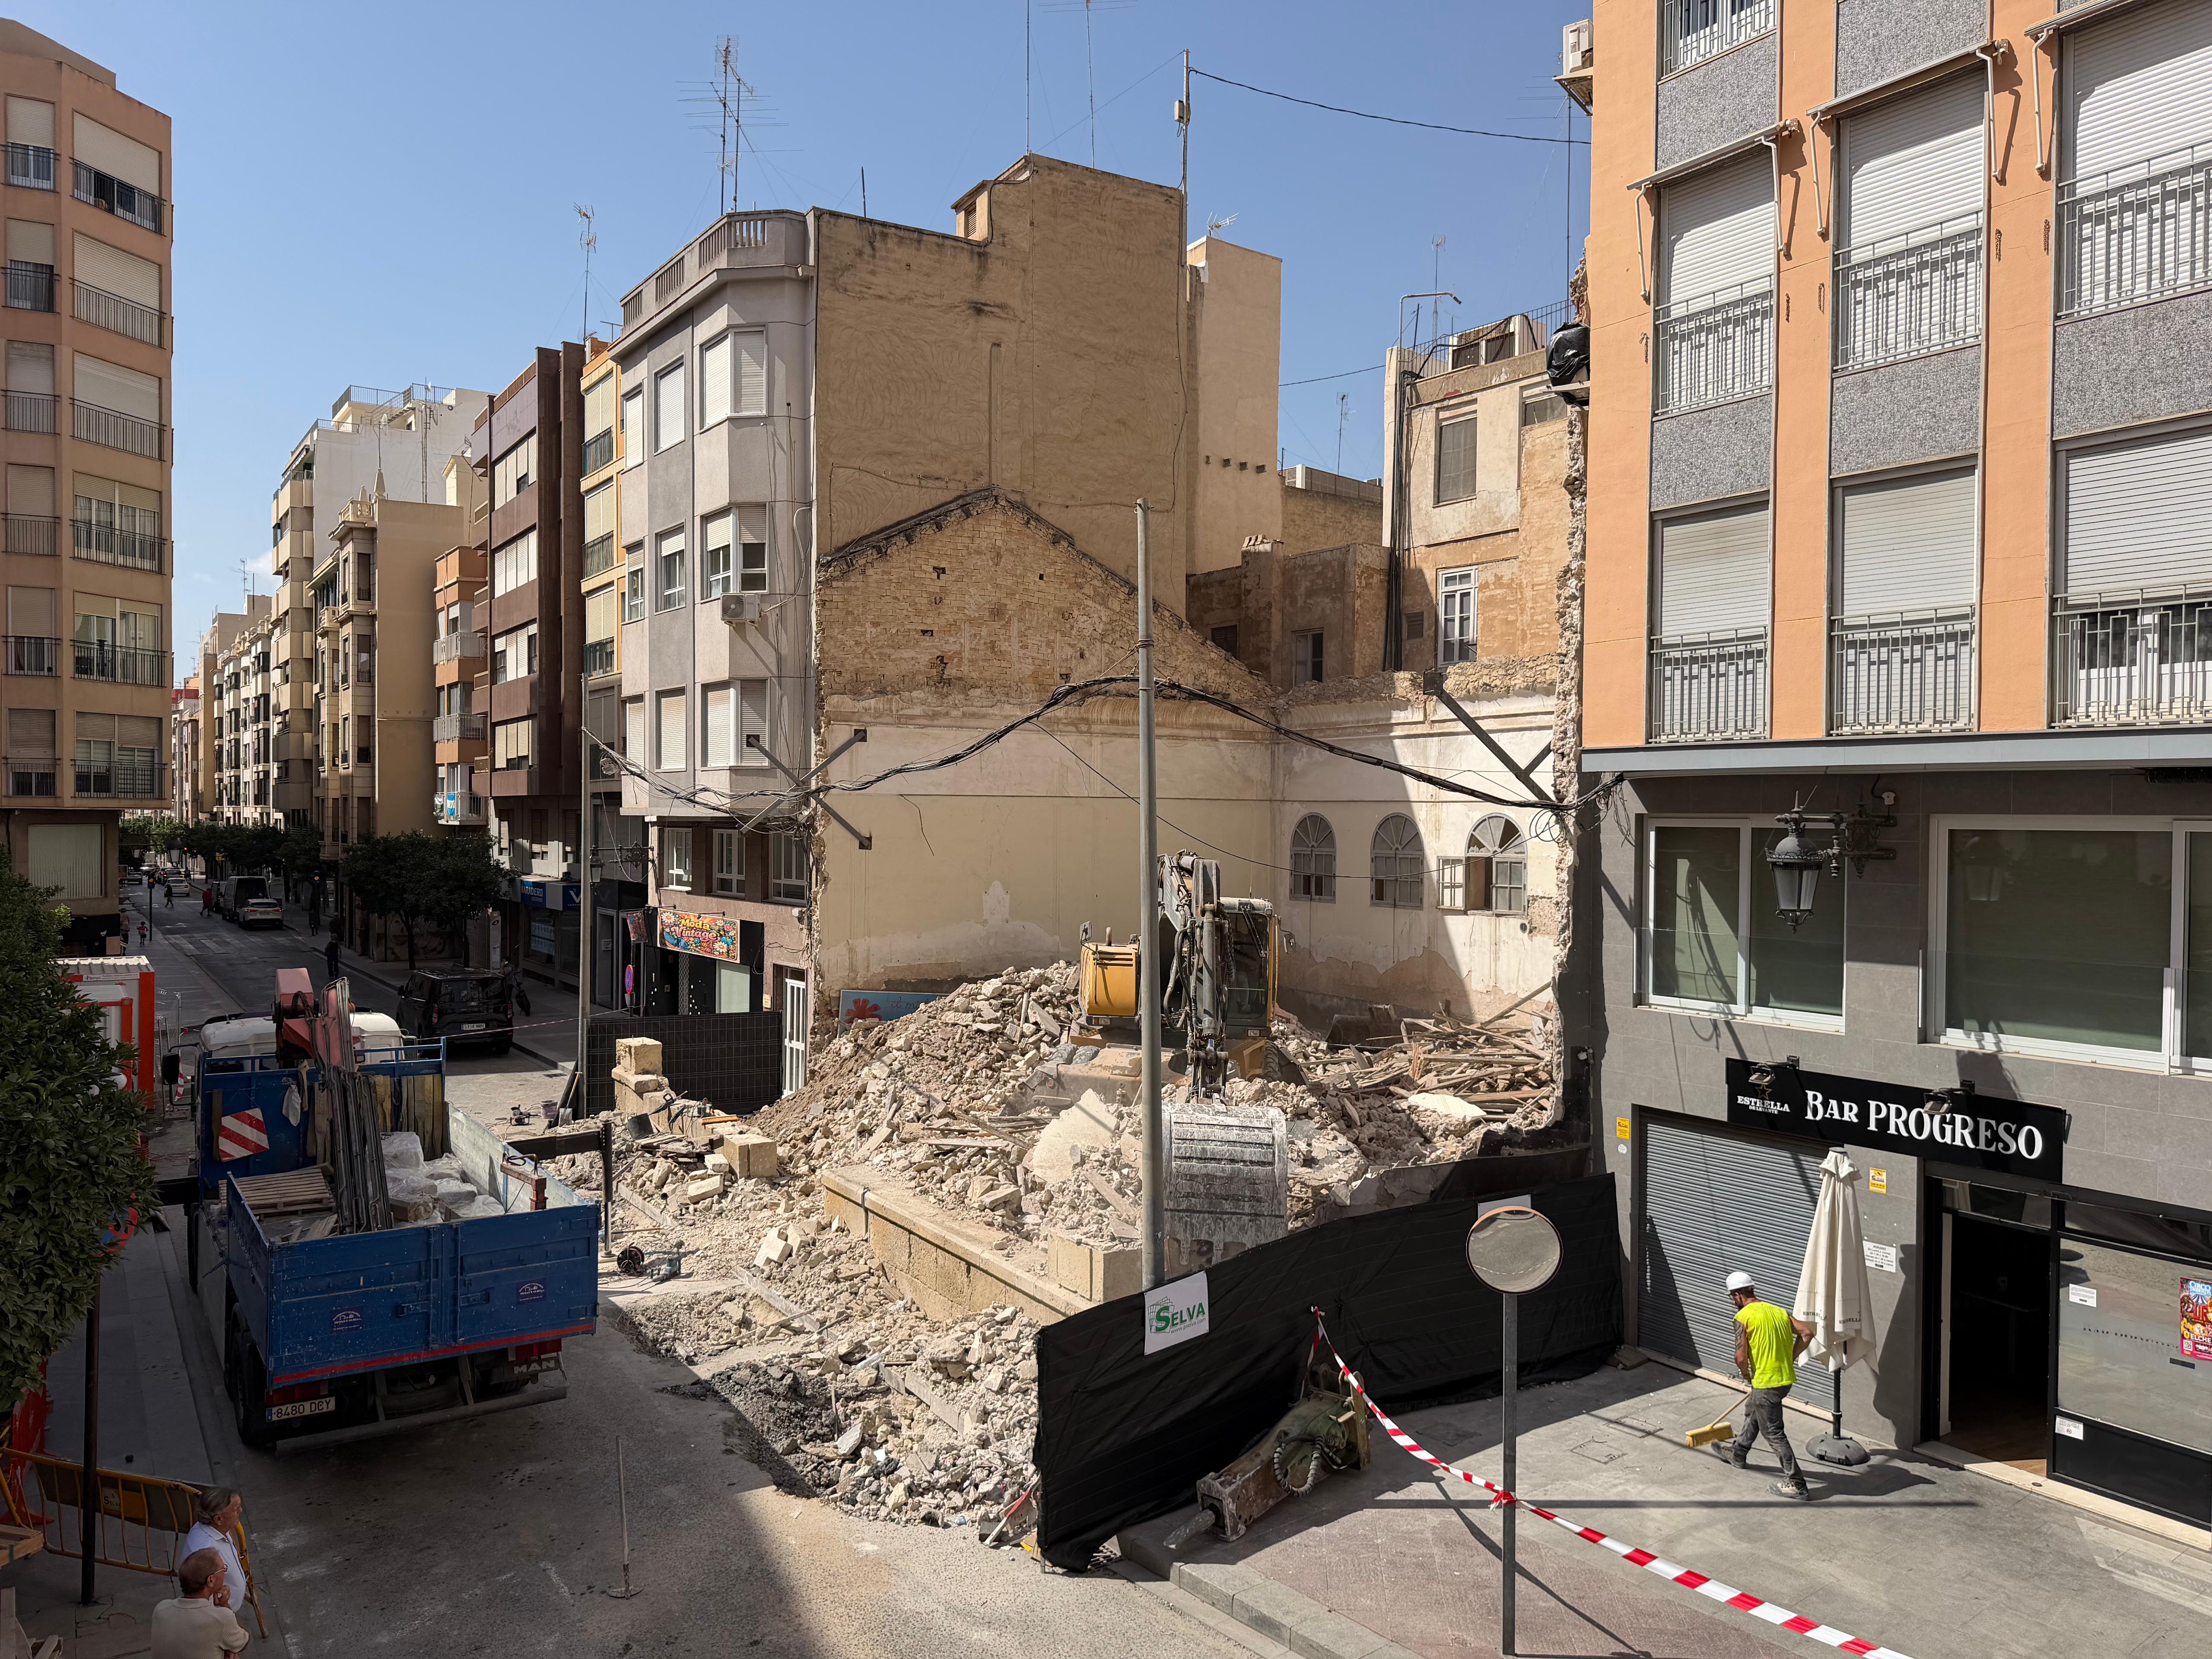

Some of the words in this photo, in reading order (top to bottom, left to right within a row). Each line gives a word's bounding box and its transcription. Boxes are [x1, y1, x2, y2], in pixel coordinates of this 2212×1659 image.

[521, 886, 543, 897] VARADERO
[679, 919, 711, 930] Moda
[671, 927, 721, 942] Vintage
[1737, 1096, 1790, 1112] ESTRELLA
[1867, 1100, 2043, 1159] PROGRESO
[1156, 1302, 1205, 1332] SELVA
[1170, 1317, 1206, 1334] www.pselva.com
[2190, 1333, 2212, 1344] ELCHE
[514, 1360, 555, 1374] MAN
[276, 1404, 305, 1418] 8480
[310, 1399, 331, 1412] DCY
